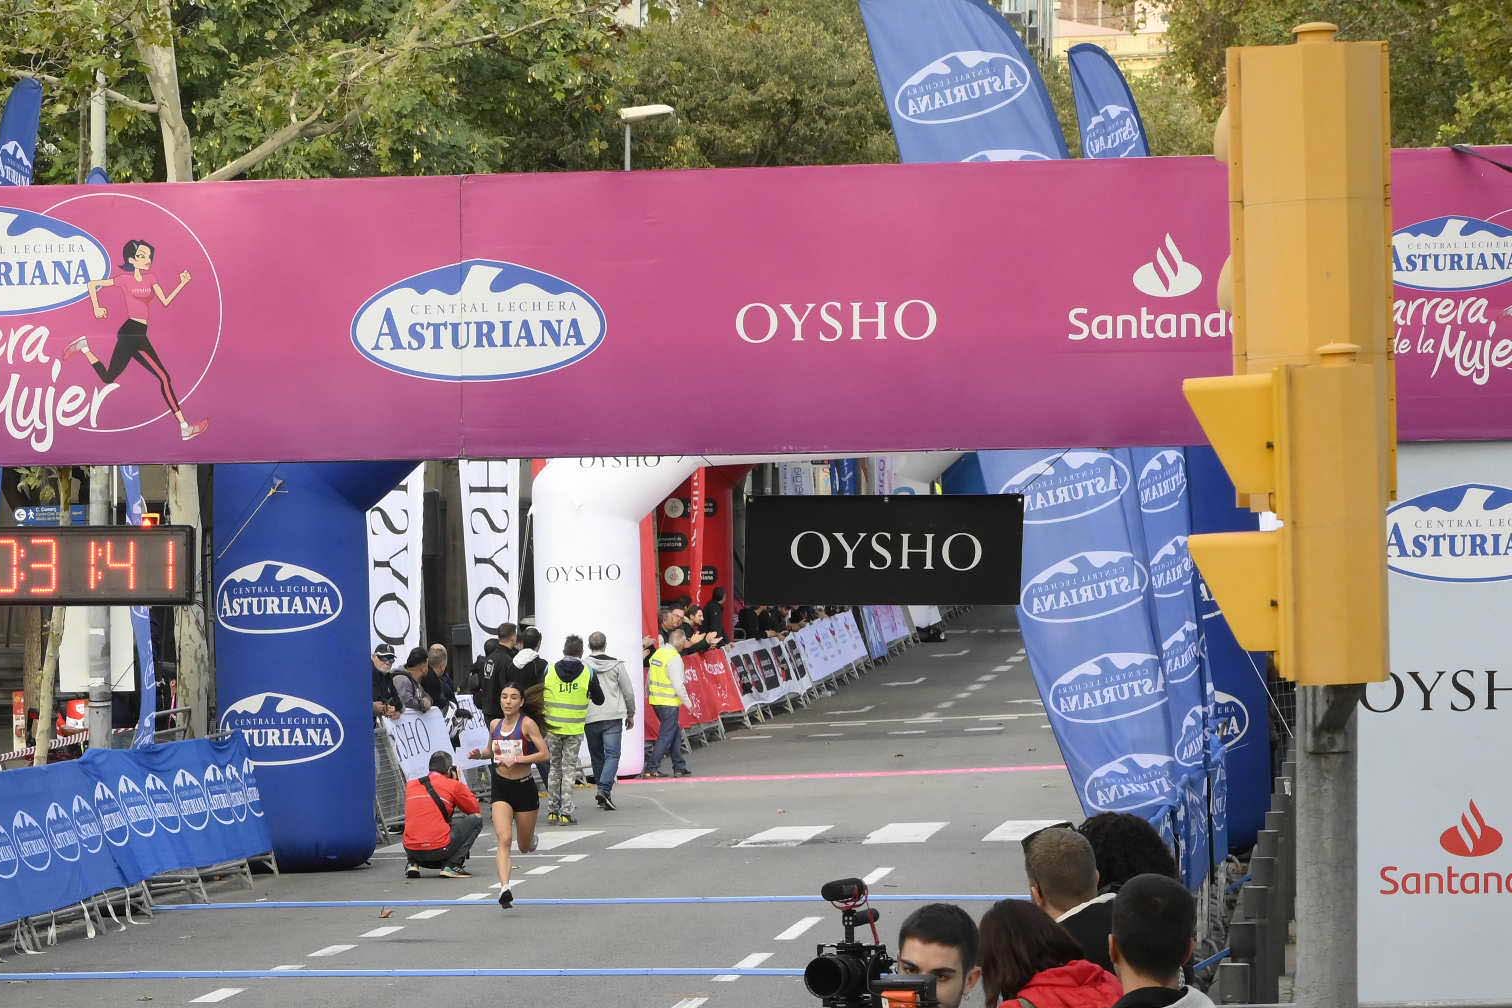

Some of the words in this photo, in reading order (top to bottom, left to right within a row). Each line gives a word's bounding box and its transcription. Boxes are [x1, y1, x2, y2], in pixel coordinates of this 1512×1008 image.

[14, 242, 86, 254] LECHERA
[1463, 241, 1512, 249] LECHER
[410, 302, 489, 315] CENTRAL
[497, 300, 577, 313] LECHERA
[1393, 296, 1489, 326] arrera
[370, 306, 586, 351] ASTURIANA
[735, 299, 937, 344] OYSHO
[1068, 307, 1234, 340] Santand
[1417, 326, 1435, 354] la
[1414, 519, 1482, 529] CENTRAL
[790, 530, 983, 571] OYSHO
[546, 563, 621, 583] OYSHO
[233, 586, 275, 594] CENTRAL
[280, 585, 328, 594] LECHERA
[220, 590, 333, 618] ASTURIANA
[235, 717, 276, 726] CENTRAL
[280, 717, 329, 725] LECHERA
